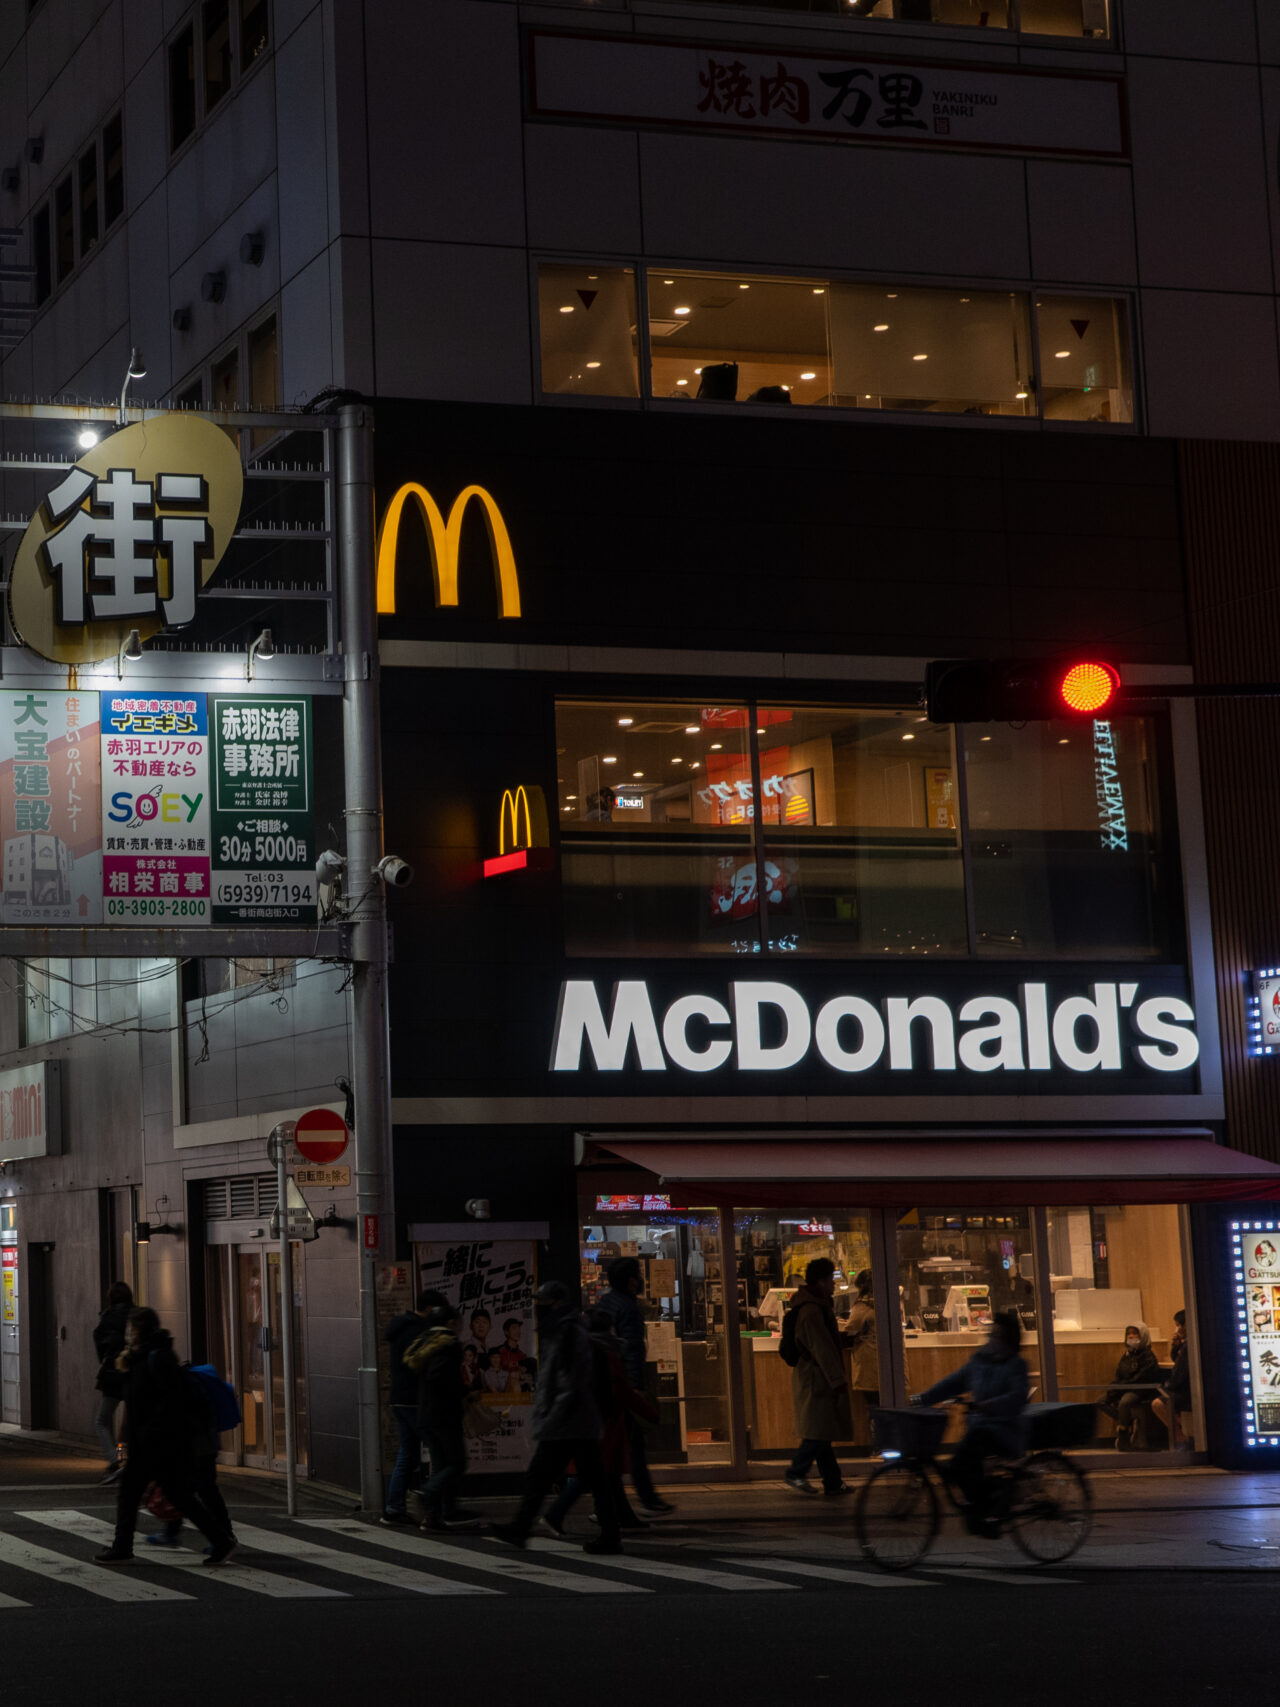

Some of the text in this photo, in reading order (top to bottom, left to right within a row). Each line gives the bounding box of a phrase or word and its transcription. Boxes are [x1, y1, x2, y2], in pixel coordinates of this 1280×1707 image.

[696, 58, 928, 131] 焼肉万里
[932, 90, 998, 107] YAKINIKU
[932, 103, 975, 119] BANRI
[111, 699, 197, 713] 地域密着不動産
[222, 707, 299, 741] 赤羽法律
[107, 739, 202, 756] 赤羽エリアの
[13, 694, 51, 832] 大宝建設
[65, 697, 82, 832] 住まいのパートナー
[113, 760, 196, 777] 不動産なら
[223, 744, 299, 777] 事務所
[108, 792, 203, 823] SOEY
[220, 836, 307, 862] 30分 5000円
[136, 859, 176, 869] 株式会社
[109, 872, 204, 893] 相栄商事
[244, 873, 284, 883] Tel:03
[217, 885, 312, 904] (5939)7194
[108, 900, 206, 916] 03-3903-2800
[230, 908, 299, 918] 一番街商店街入口
[551, 980, 1200, 1073] McDonald's
[297, 1170, 347, 1183] 自転車を除く
[420, 1241, 493, 1277] 一緒に
